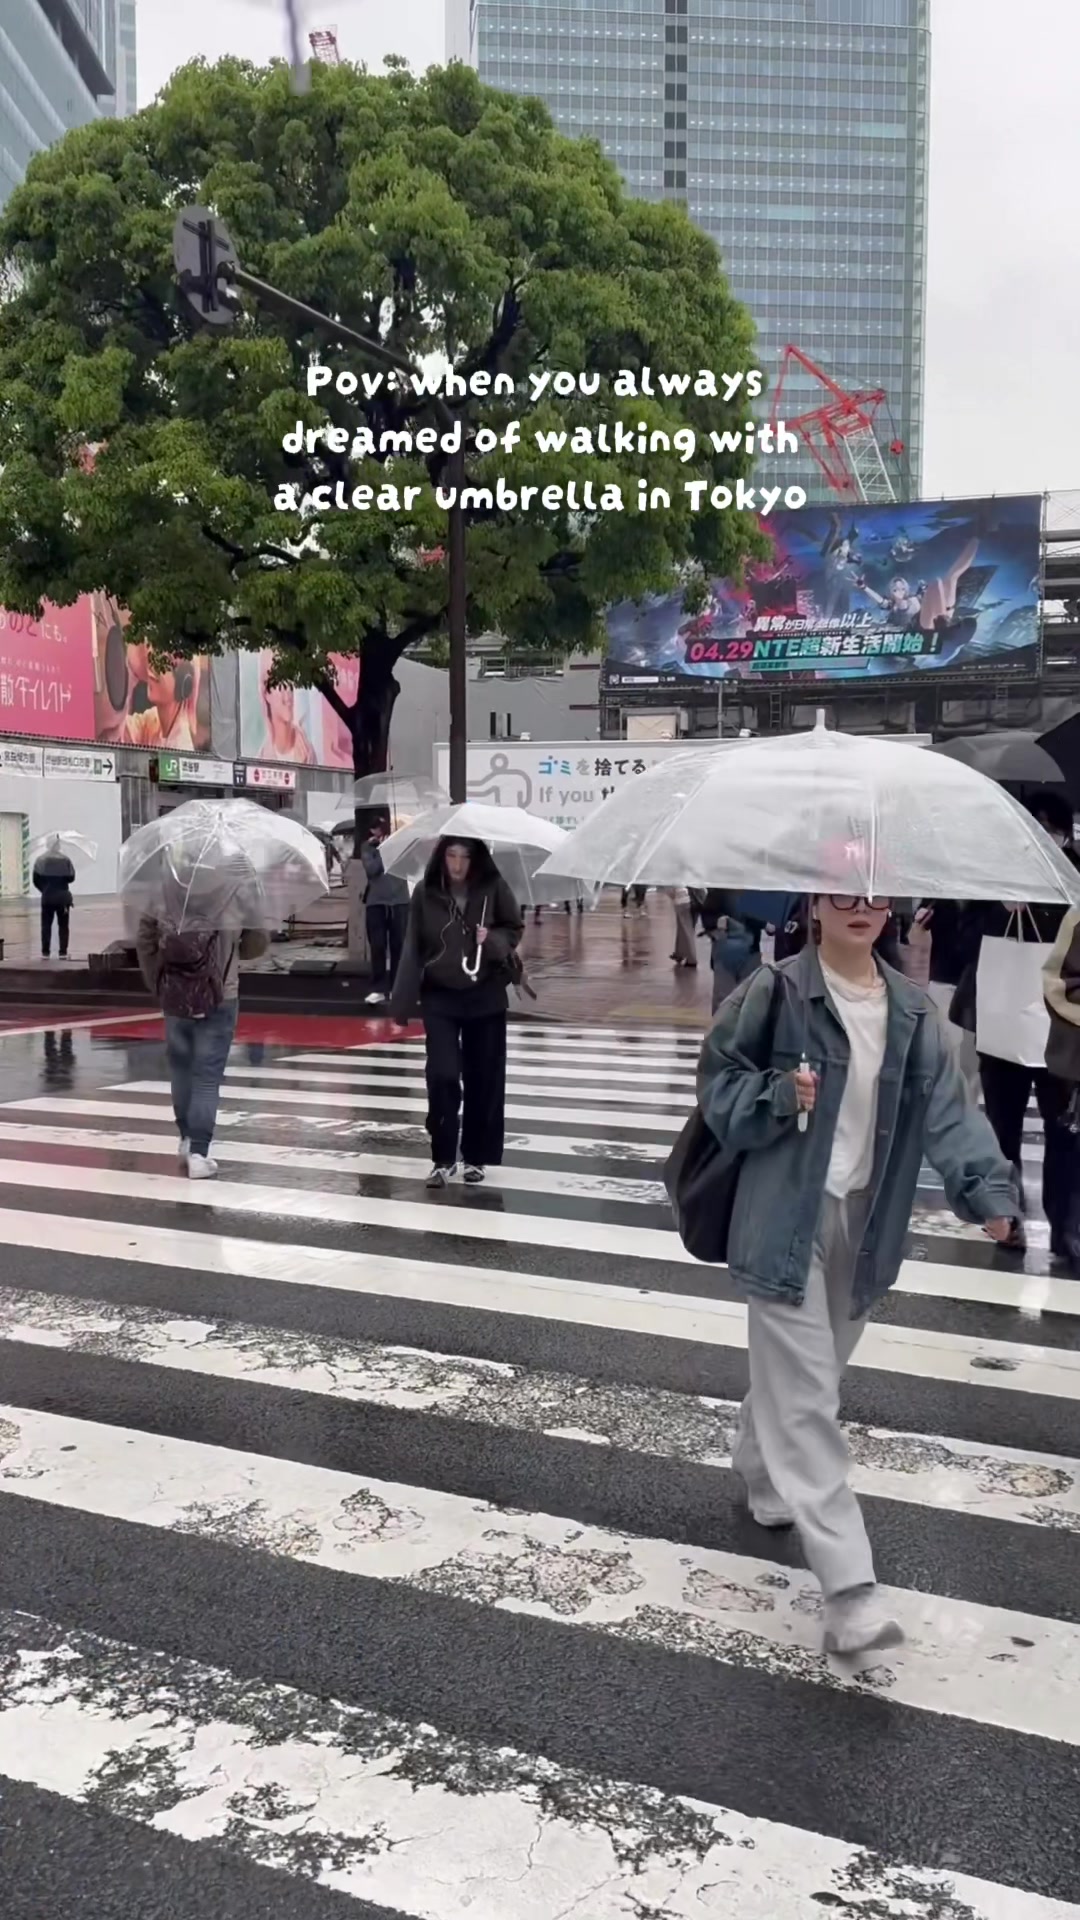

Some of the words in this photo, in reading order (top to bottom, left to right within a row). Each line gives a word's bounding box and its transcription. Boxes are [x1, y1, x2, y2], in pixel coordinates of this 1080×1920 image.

[166, 760, 178, 772] JR
[538, 755, 659, 776] ゴミを捨てる
[540, 786, 553, 803] If
[559, 790, 595, 807] you
